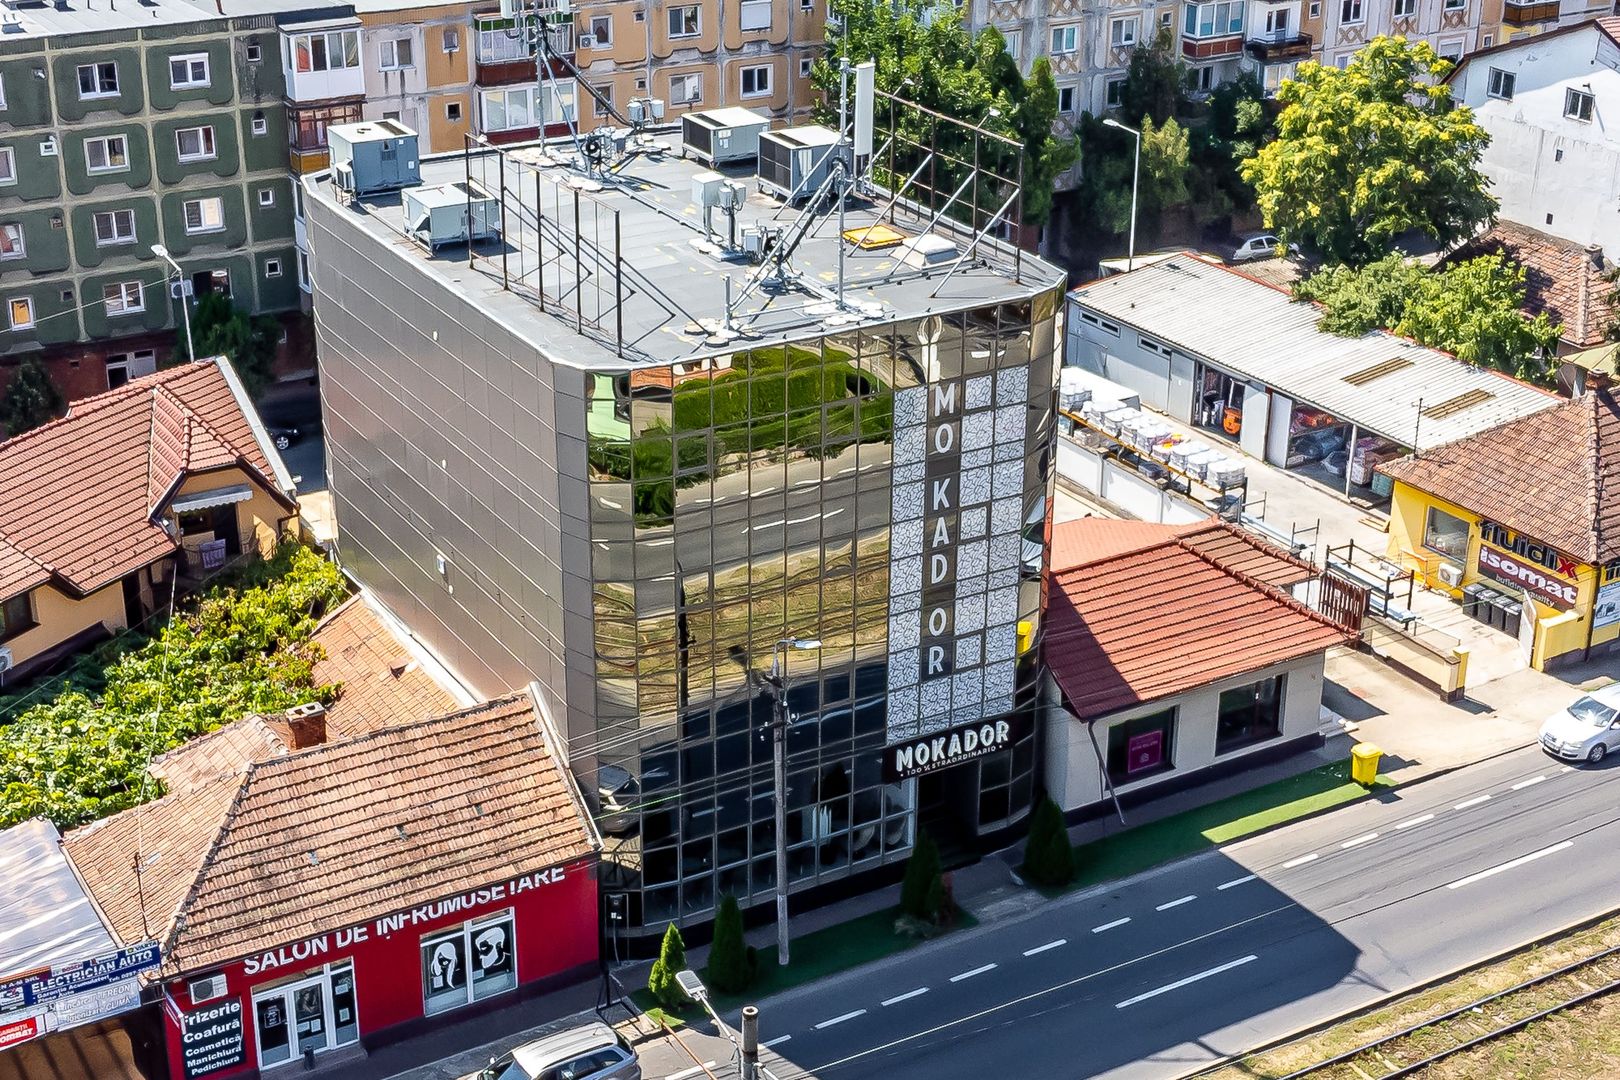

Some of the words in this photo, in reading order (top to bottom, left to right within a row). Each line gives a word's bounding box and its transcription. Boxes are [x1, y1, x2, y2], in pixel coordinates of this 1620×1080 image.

[928, 382, 955, 675] MOKADOR
[1480, 546, 1577, 604] isomat
[1528, 591, 1555, 607] quality
[896, 720, 1010, 772] MOKADOR
[931, 746, 996, 769] STRAORDINARIO
[32, 962, 116, 993] ELECTRICIAN
[119, 950, 153, 969] AUTO
[244, 934, 328, 975] SALON
[335, 926, 368, 948] DE
